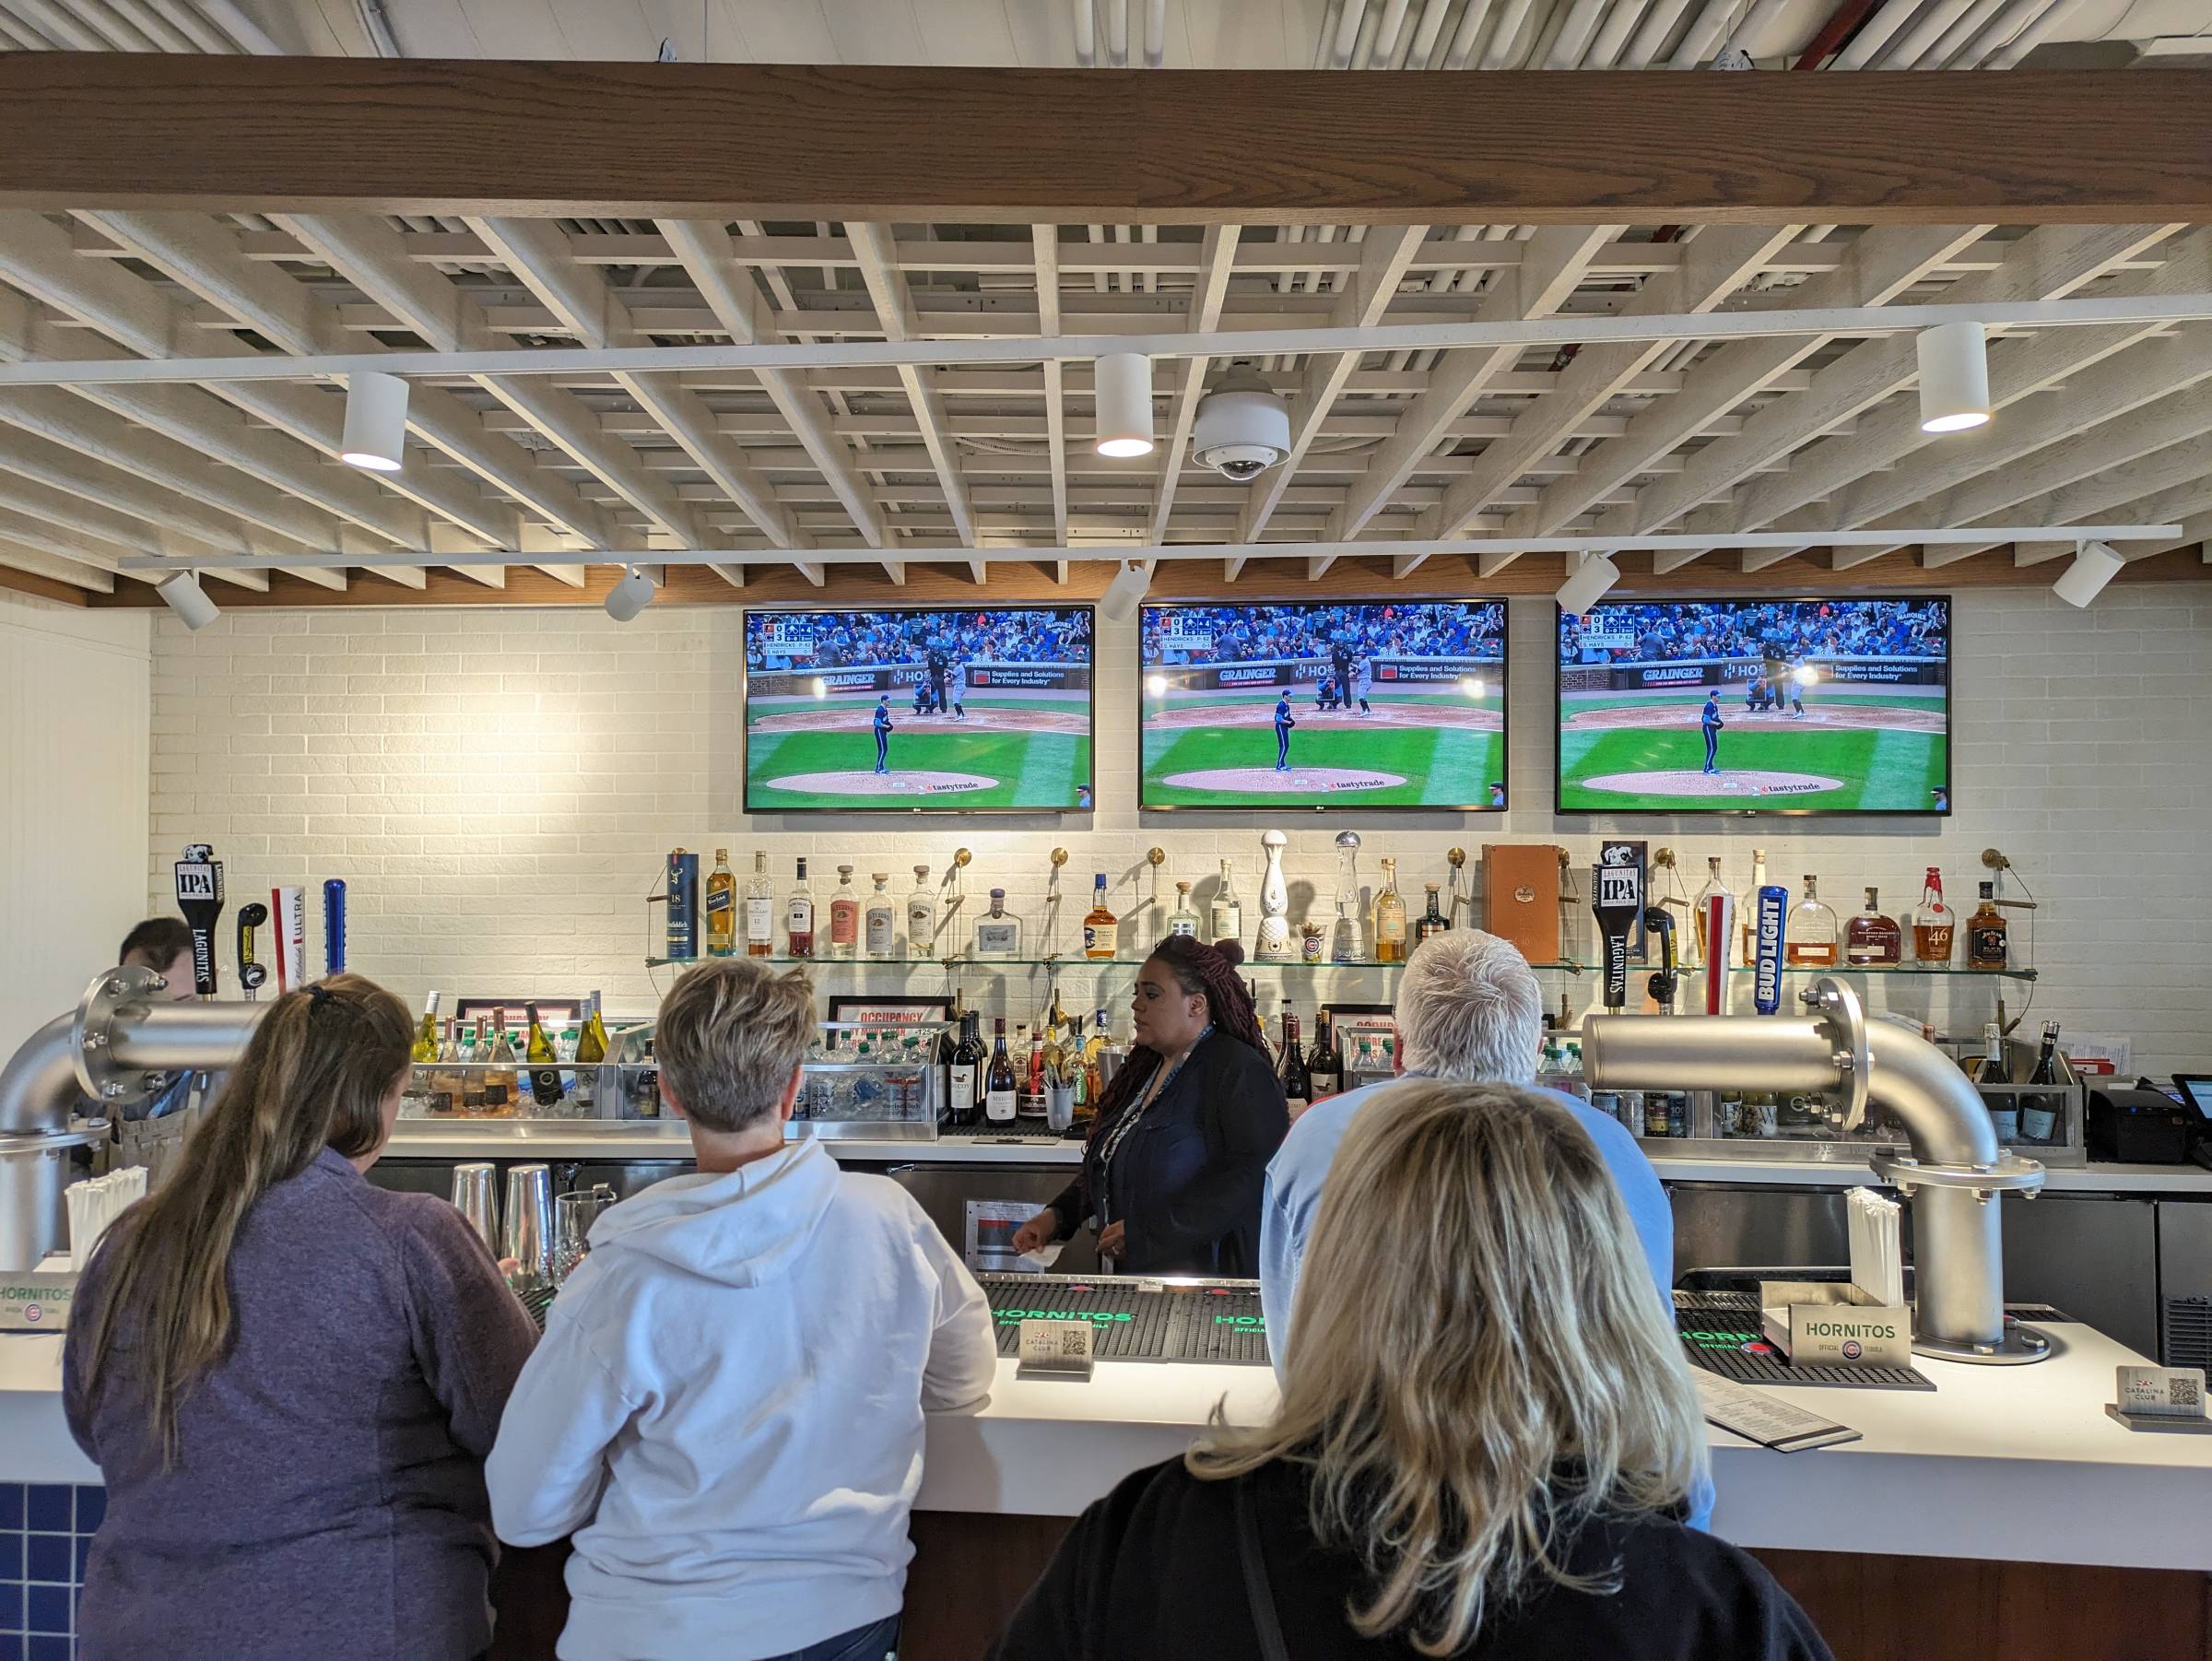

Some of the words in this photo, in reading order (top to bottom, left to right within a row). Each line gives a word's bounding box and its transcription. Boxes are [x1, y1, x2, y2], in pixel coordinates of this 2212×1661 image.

[1219, 668, 1276, 680] GRAINGER
[1642, 667, 1703, 680] GRAINGER
[1835, 665, 1866, 673] Supplies
[821, 674, 876, 686] GRAINGER
[933, 783, 979, 791] tastytrade
[1336, 780, 1385, 789] tastytrade
[1768, 783, 1821, 792] tastytrade
[180, 874, 211, 892] IPA
[1603, 879, 1636, 900] IPA
[294, 892, 302, 937] ULTRA
[1760, 899, 1780, 957] LIGHT
[1930, 928, 1948, 946] 46
[193, 929, 209, 983] LAGUNITAS
[1609, 936, 1625, 994] LAGUNITAS
[1758, 959, 1776, 1000] BUD
[861, 1012, 923, 1022] OCCUPANCY
[1806, 1323, 1896, 1338] HORNITOS
